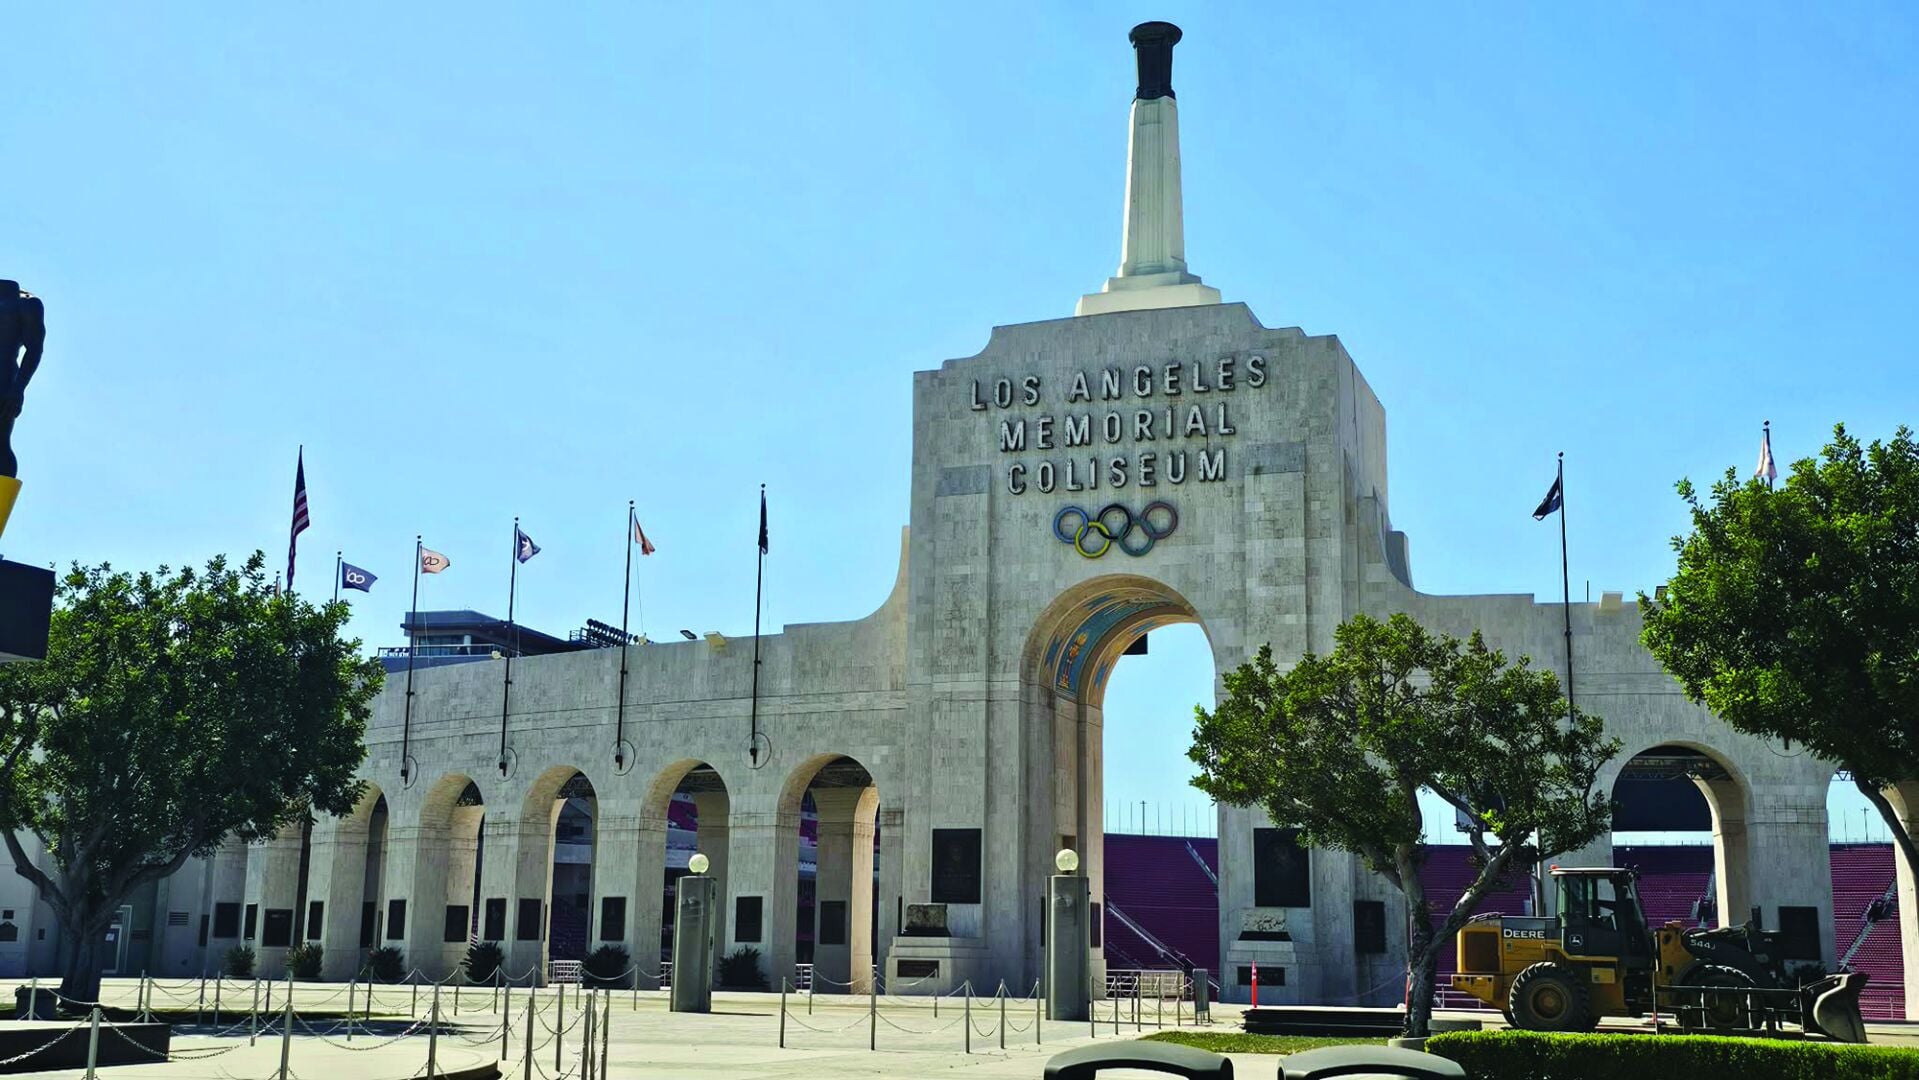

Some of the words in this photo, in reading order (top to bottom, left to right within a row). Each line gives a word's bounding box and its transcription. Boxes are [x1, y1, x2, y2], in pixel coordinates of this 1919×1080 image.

[970, 375, 1041, 411] LOS
[1069, 355, 1266, 403] ANGELES
[1000, 402, 1235, 452] MEMORIAL
[1007, 448, 1225, 495] COLISEUM
[1503, 928, 1545, 939] DEERE
